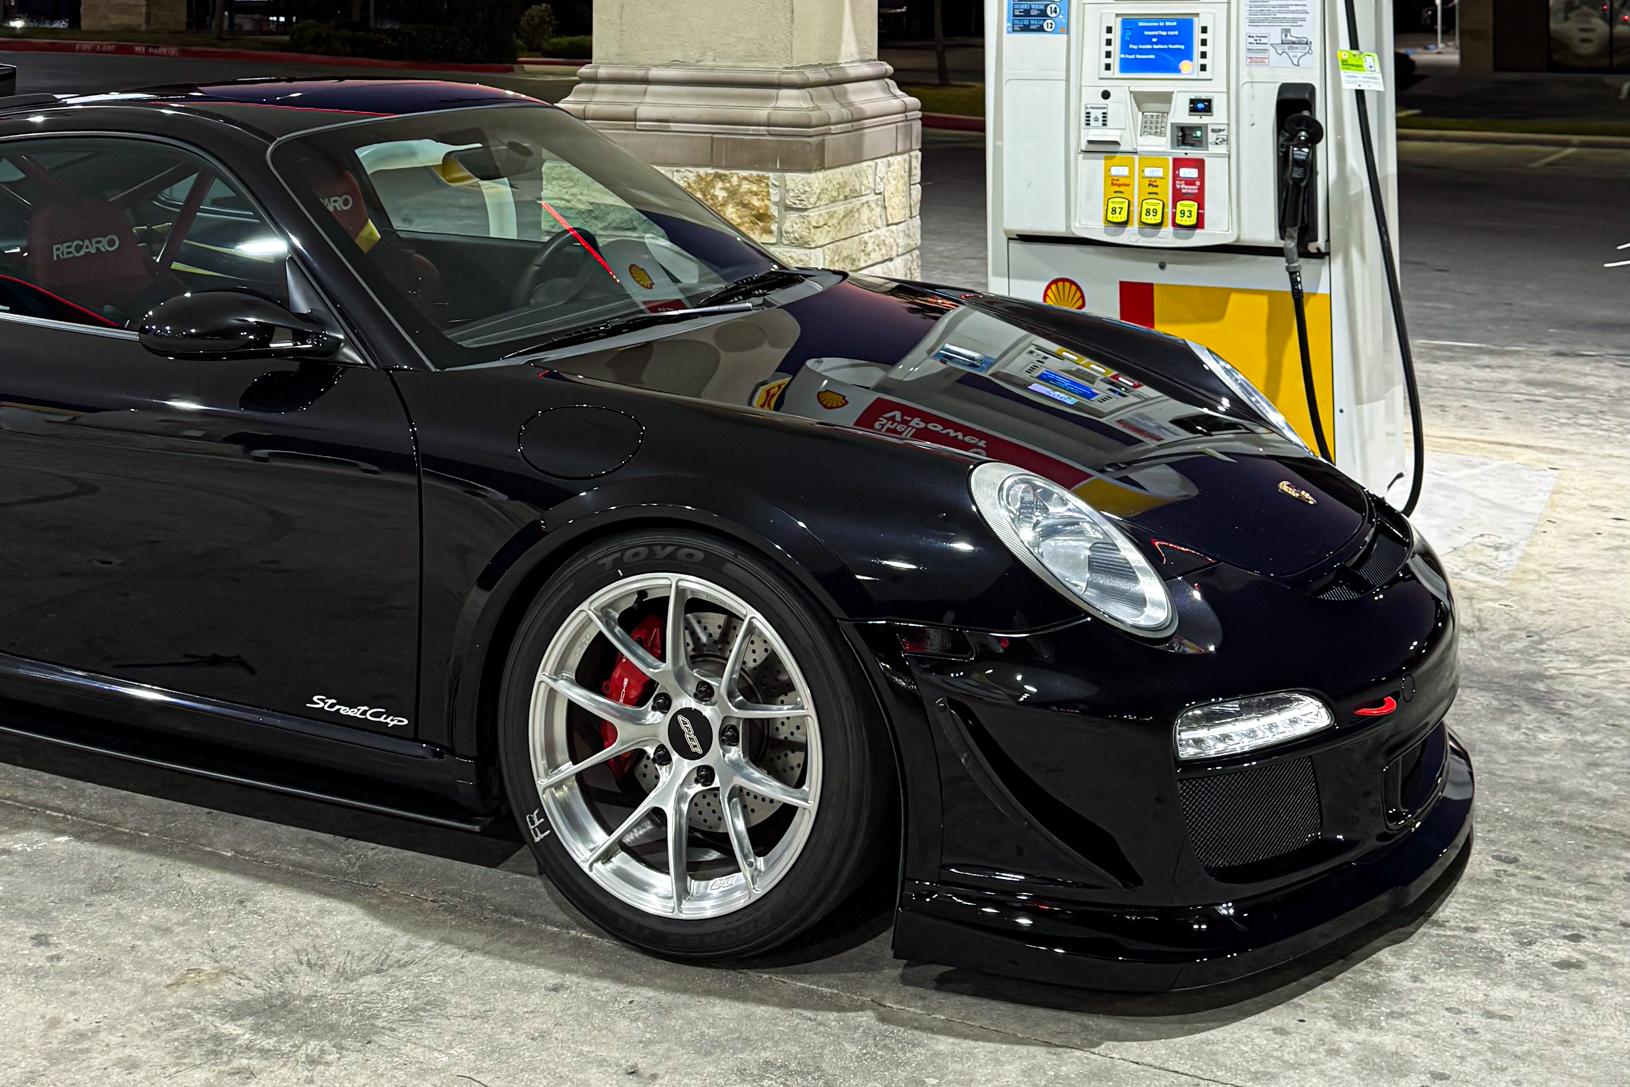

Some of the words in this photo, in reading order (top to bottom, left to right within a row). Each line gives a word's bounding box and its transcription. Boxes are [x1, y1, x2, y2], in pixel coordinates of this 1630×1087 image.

[1049, 6, 1058, 15] 14
[1110, 206, 1124, 216] 87
[1144, 207, 1158, 217] 89
[1179, 209, 1193, 219] 93
[52, 234, 120, 261] RECARO
[598, 545, 705, 570] TOYO
[526, 807, 551, 843] FR
